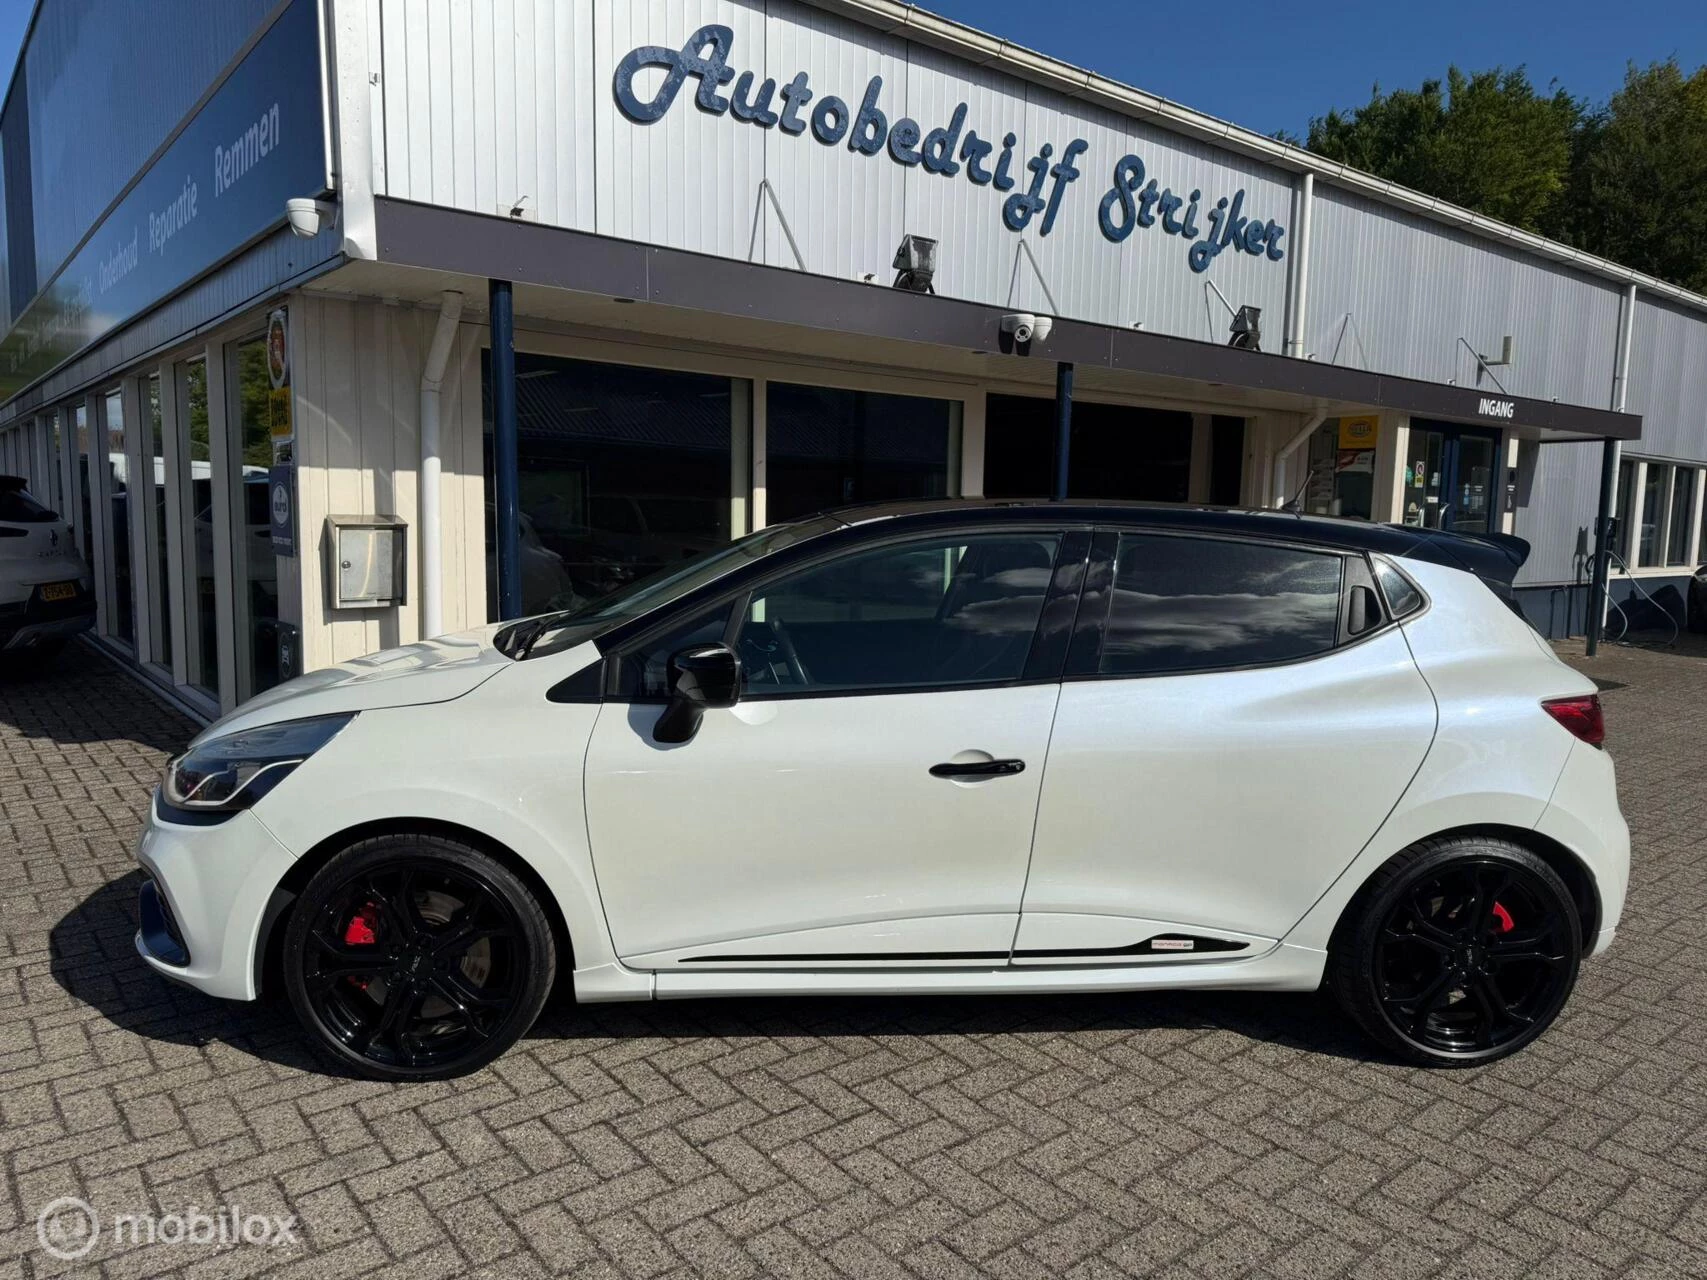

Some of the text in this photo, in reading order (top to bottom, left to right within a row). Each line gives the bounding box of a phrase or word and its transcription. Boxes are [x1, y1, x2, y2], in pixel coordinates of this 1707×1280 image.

[149, 175, 198, 256] Reparatie
[214, 103, 280, 198] Remmen
[612, 24, 1285, 274] Autobedrijf Strijker
[1478, 398, 1514, 418] INGANG
